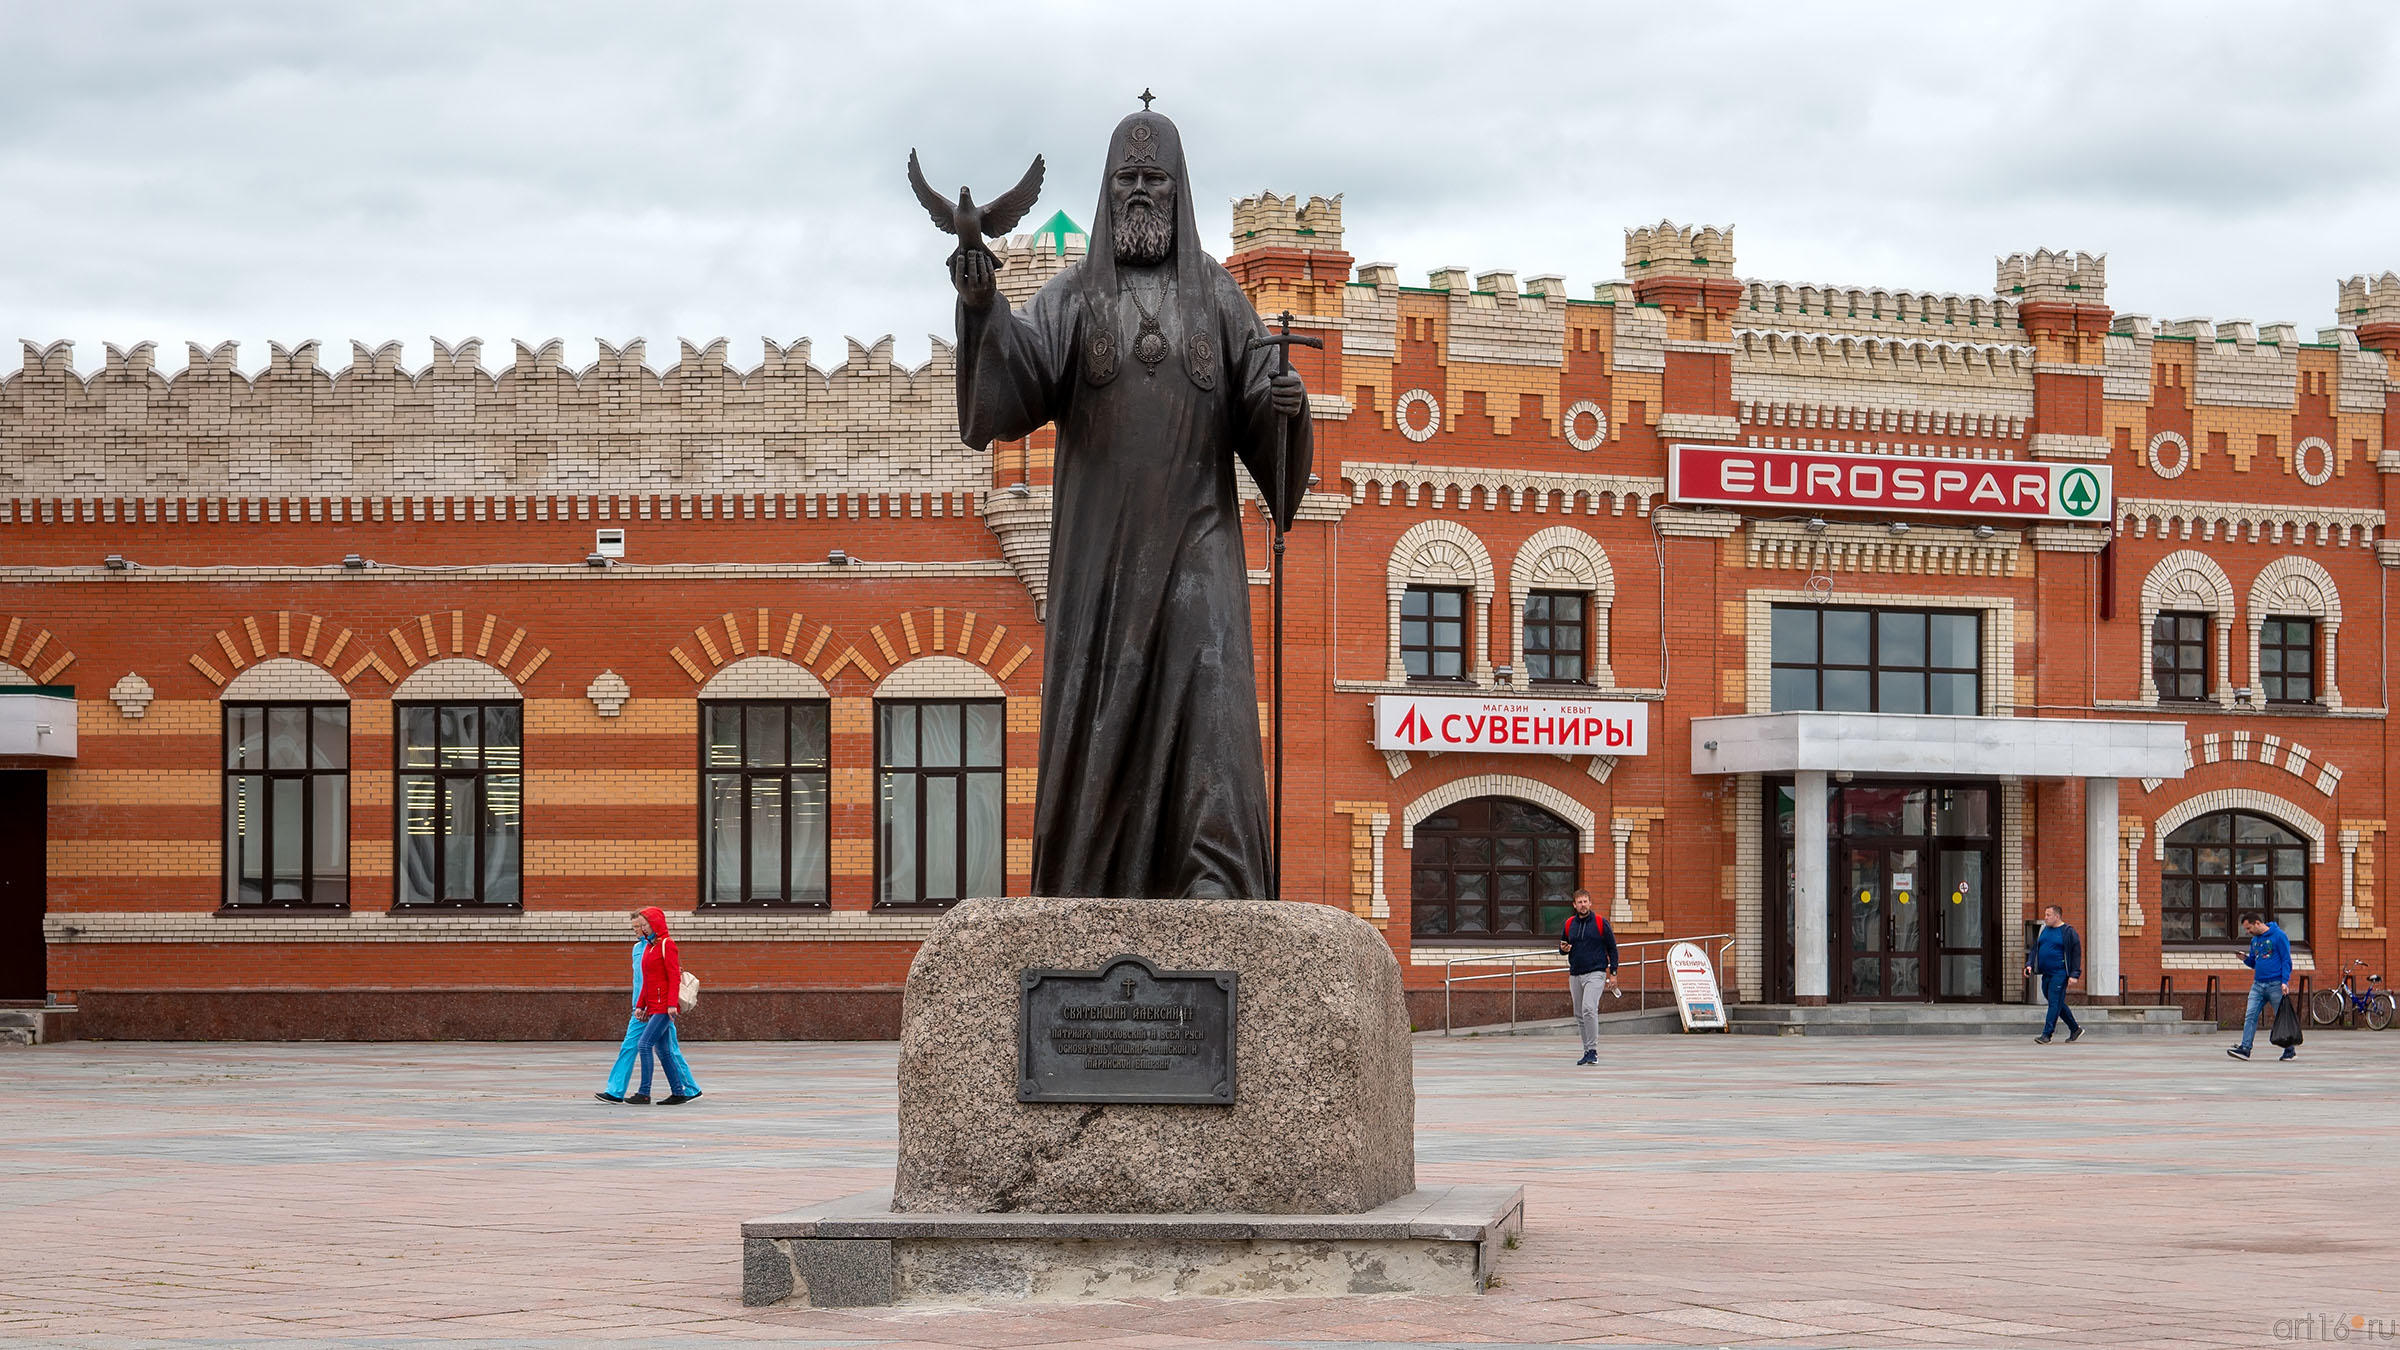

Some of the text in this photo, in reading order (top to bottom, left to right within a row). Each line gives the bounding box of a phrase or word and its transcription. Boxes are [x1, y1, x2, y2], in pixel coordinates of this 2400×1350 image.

[1720, 458, 2046, 508] EUROSPAR
[1482, 703, 1593, 714] МАГАЗИН КЕВЫТ
[1441, 713, 1633, 747] СУВЕНИРЫ
[1063, 1005, 1127, 1020] СВЯТЕЙШИЙ
[1132, 1005, 1179, 1020] АЛЕКСИЙ
[1052, 1029, 1092, 1039] ПАТРИАРХ
[1160, 1029, 1180, 1039] ВСЕЯ
[1185, 1030, 1204, 1039] РУСИ
